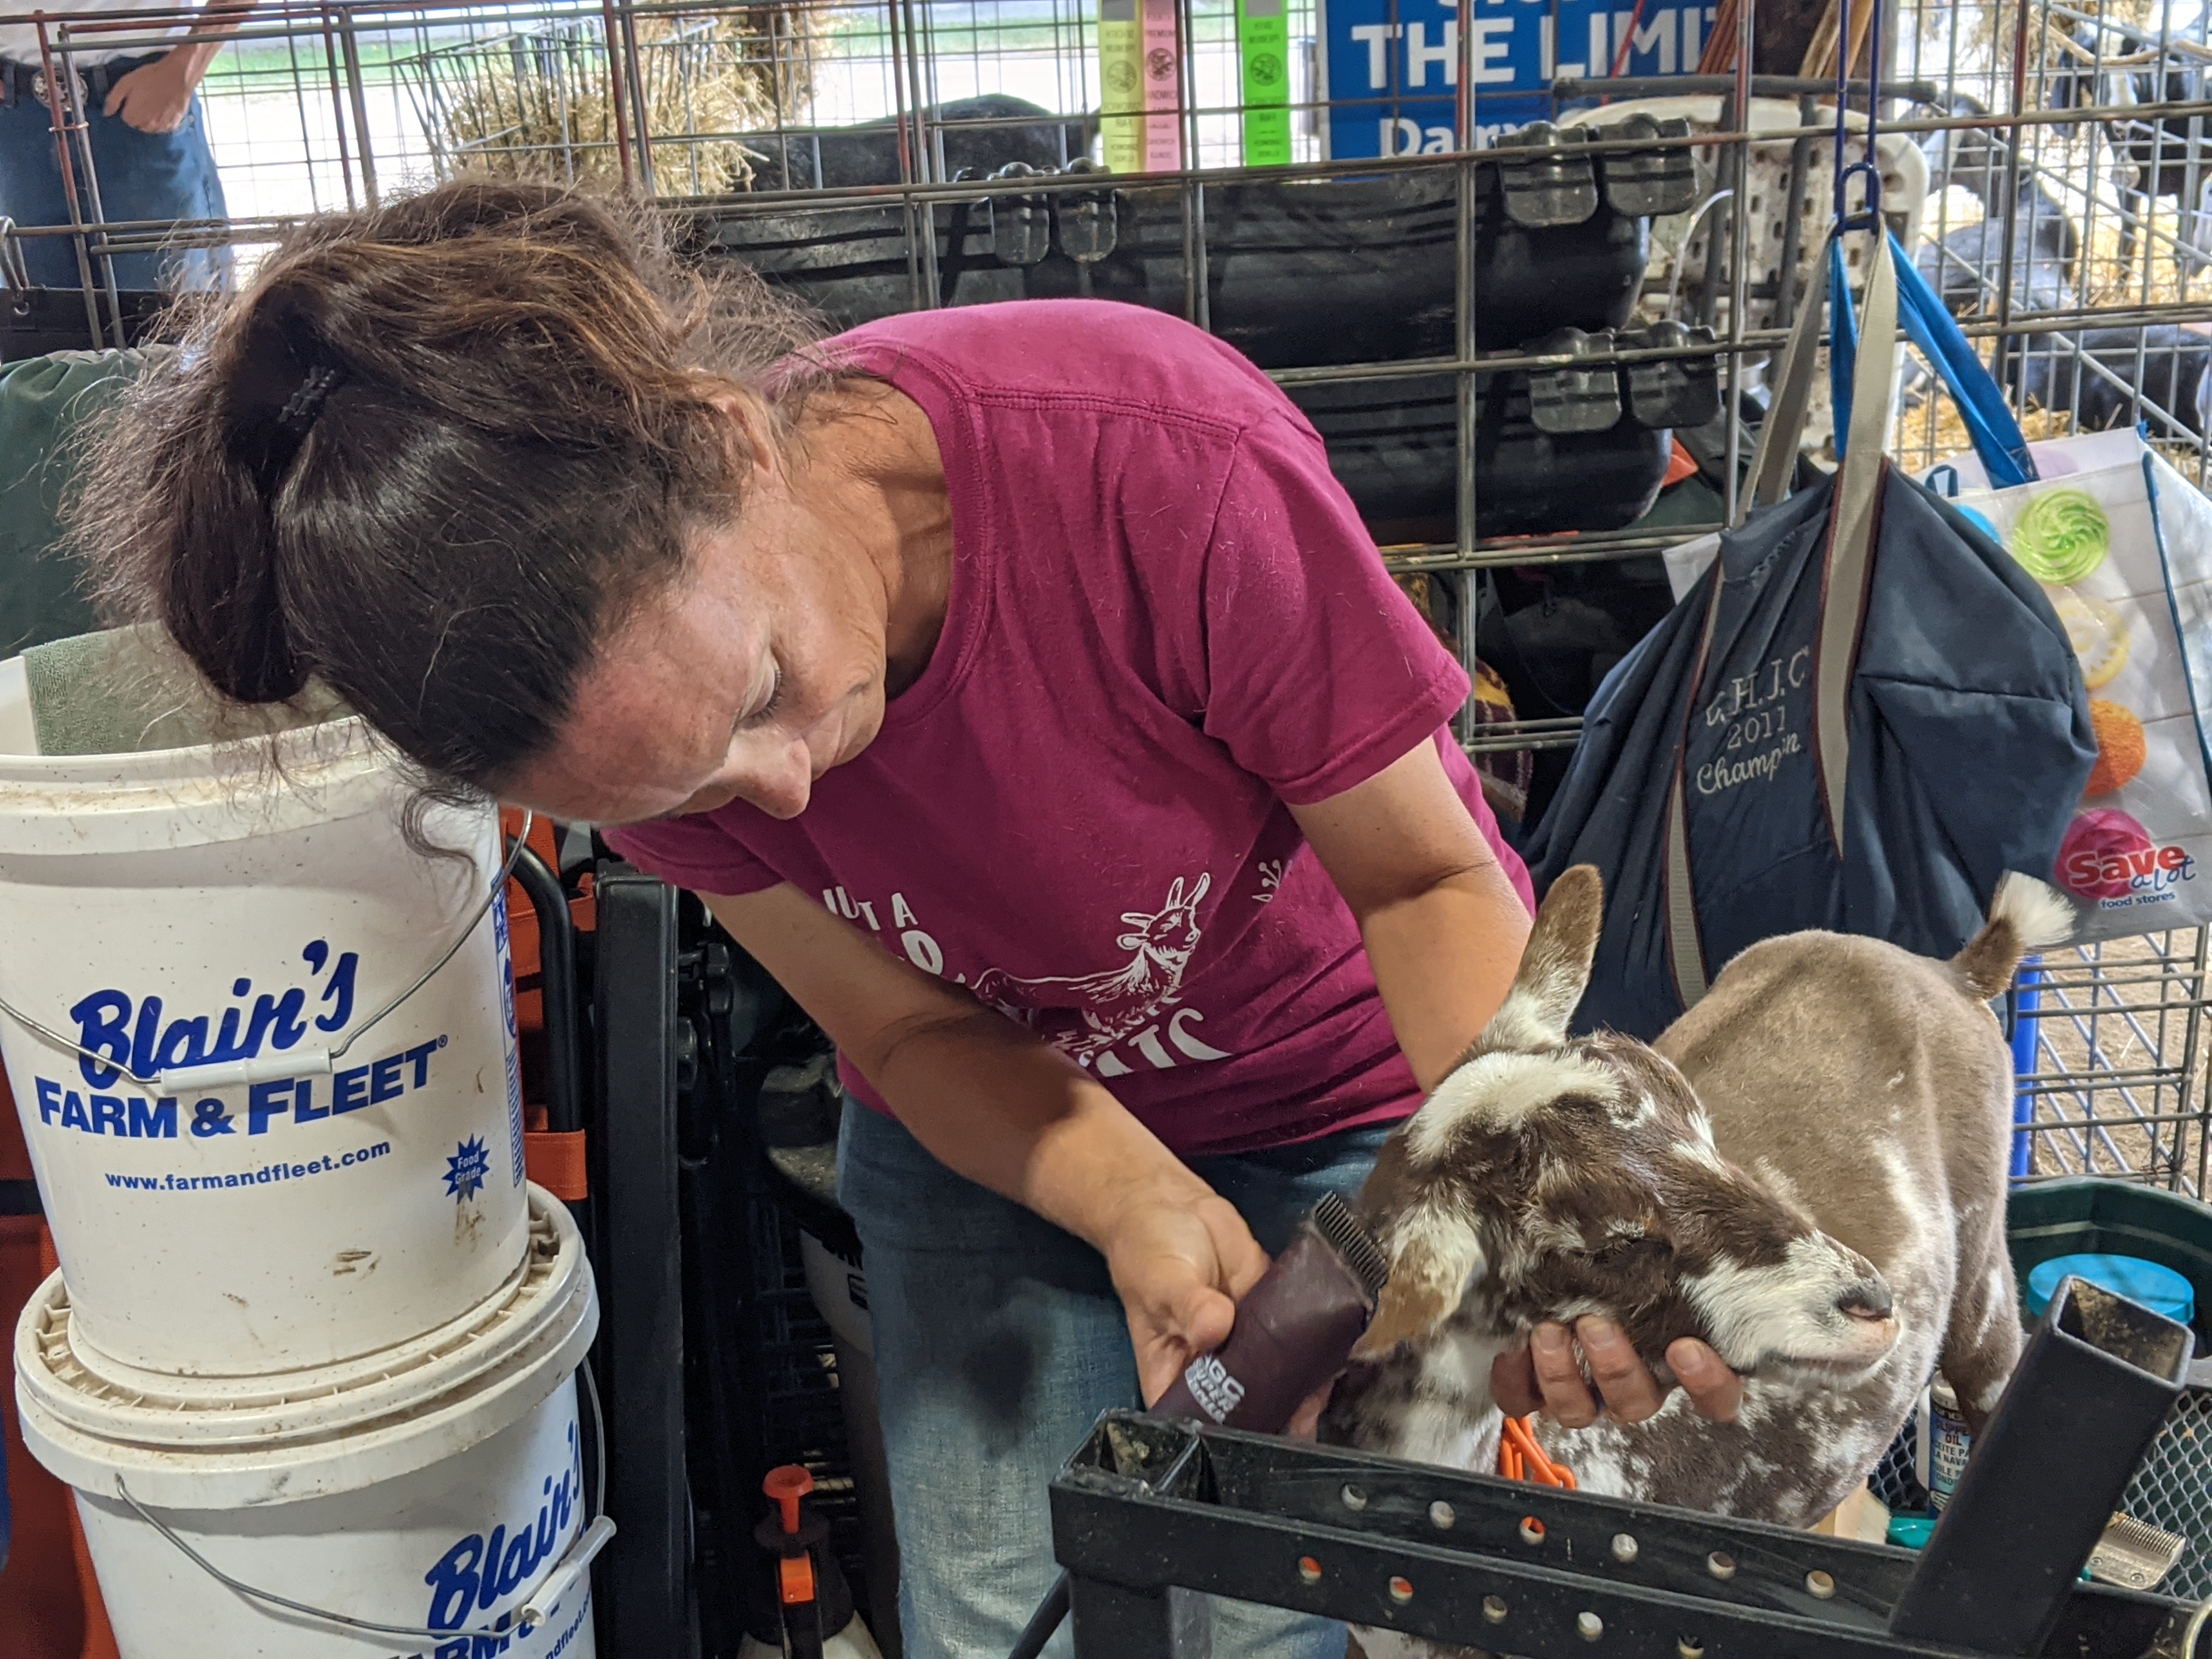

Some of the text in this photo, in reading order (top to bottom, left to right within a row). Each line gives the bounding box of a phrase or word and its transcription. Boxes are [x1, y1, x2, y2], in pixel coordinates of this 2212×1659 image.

[1351, 7, 1718, 89] THE LIMI
[1728, 706, 1786, 749] 2011
[2068, 846, 2186, 885] Save
[2101, 891, 2176, 909] food stores
[70, 940, 359, 1090] Blain's
[34, 1075, 178, 1138] FARM
[190, 1098, 236, 1137] &
[105, 1141, 391, 1190] www.farmandfleet.com
[455, 1166, 481, 1184] Grade
[458, 1150, 479, 1170] Food
[1946, 1434, 1962, 1446] OIL
[425, 1420, 580, 1639] Blain's
